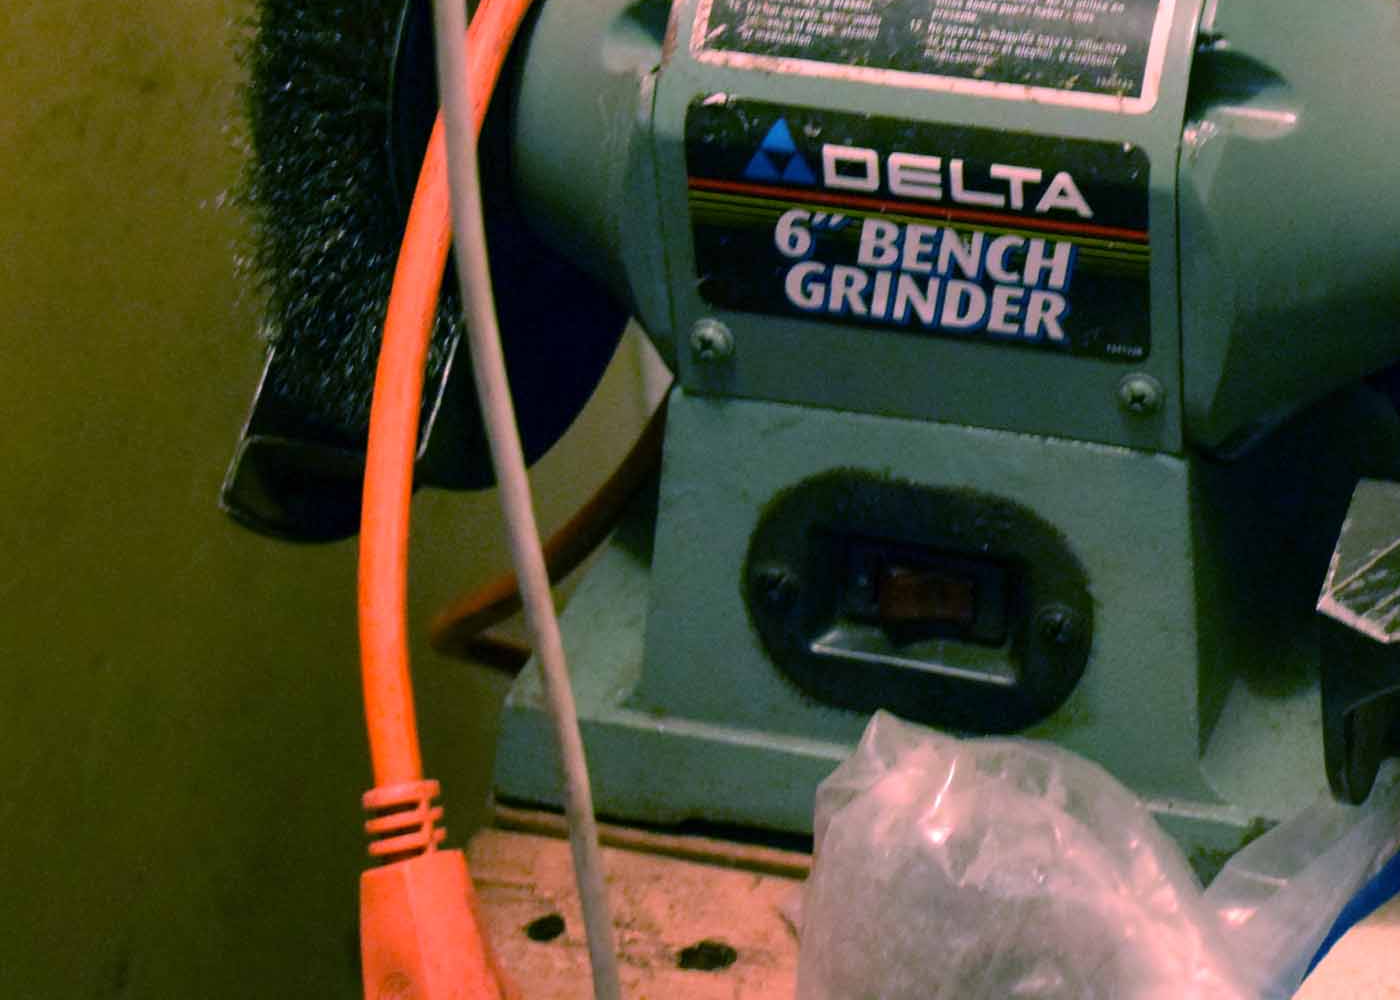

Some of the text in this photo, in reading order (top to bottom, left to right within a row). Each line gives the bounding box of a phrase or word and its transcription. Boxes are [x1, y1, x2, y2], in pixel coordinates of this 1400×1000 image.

[822, 143, 1093, 218] DELTA
[857, 217, 1072, 290] BENCH
[784, 260, 1067, 340] GRINDER
